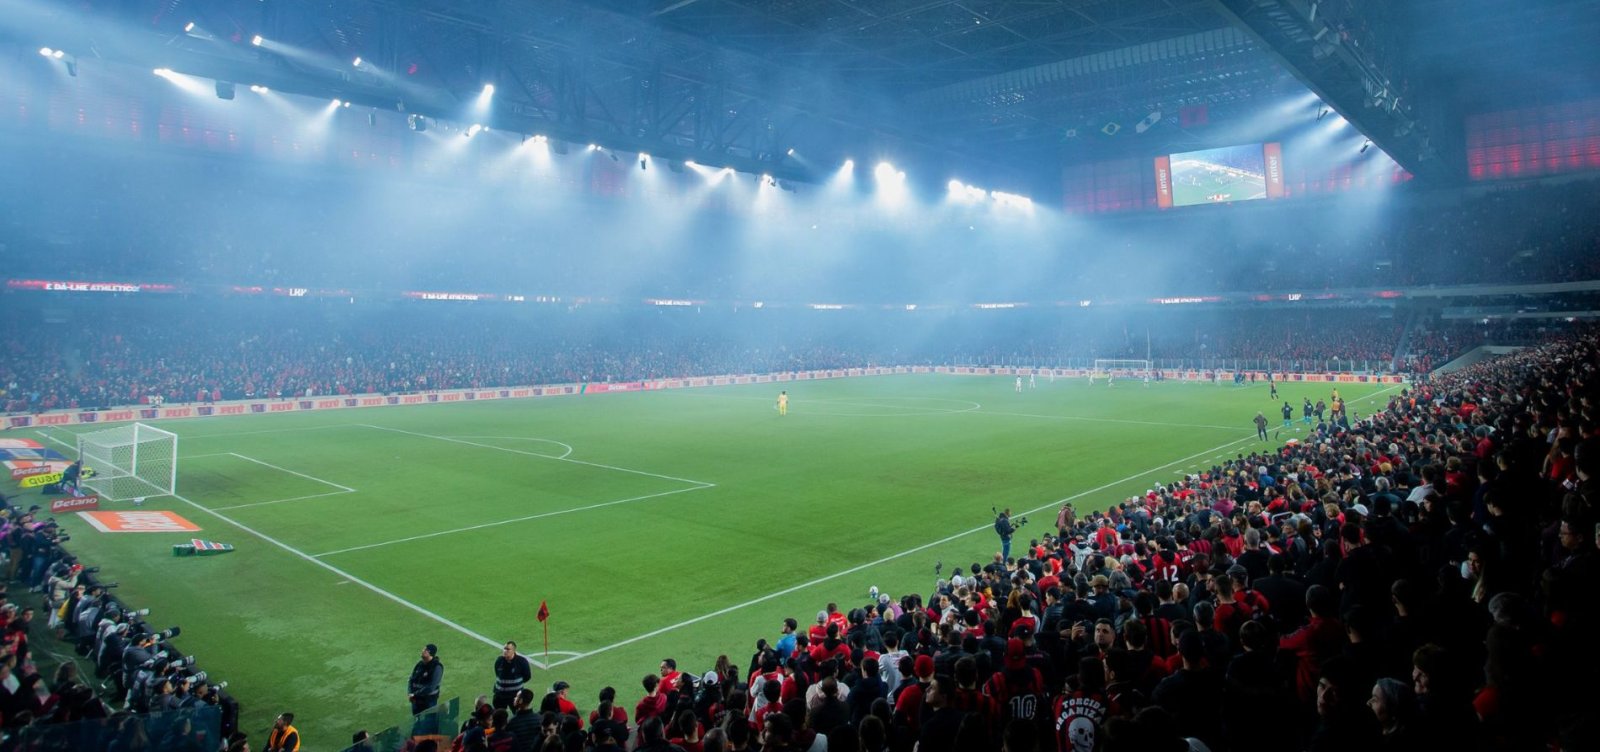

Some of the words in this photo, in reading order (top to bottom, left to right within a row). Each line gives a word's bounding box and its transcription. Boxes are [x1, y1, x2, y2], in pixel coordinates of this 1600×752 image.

[52, 497, 98, 509] Betano
[1162, 564, 1179, 582] 12
[1008, 693, 1037, 721] 10
[1061, 697, 1107, 715] TORCIDA
[1055, 706, 1104, 731] ORGANIZA
